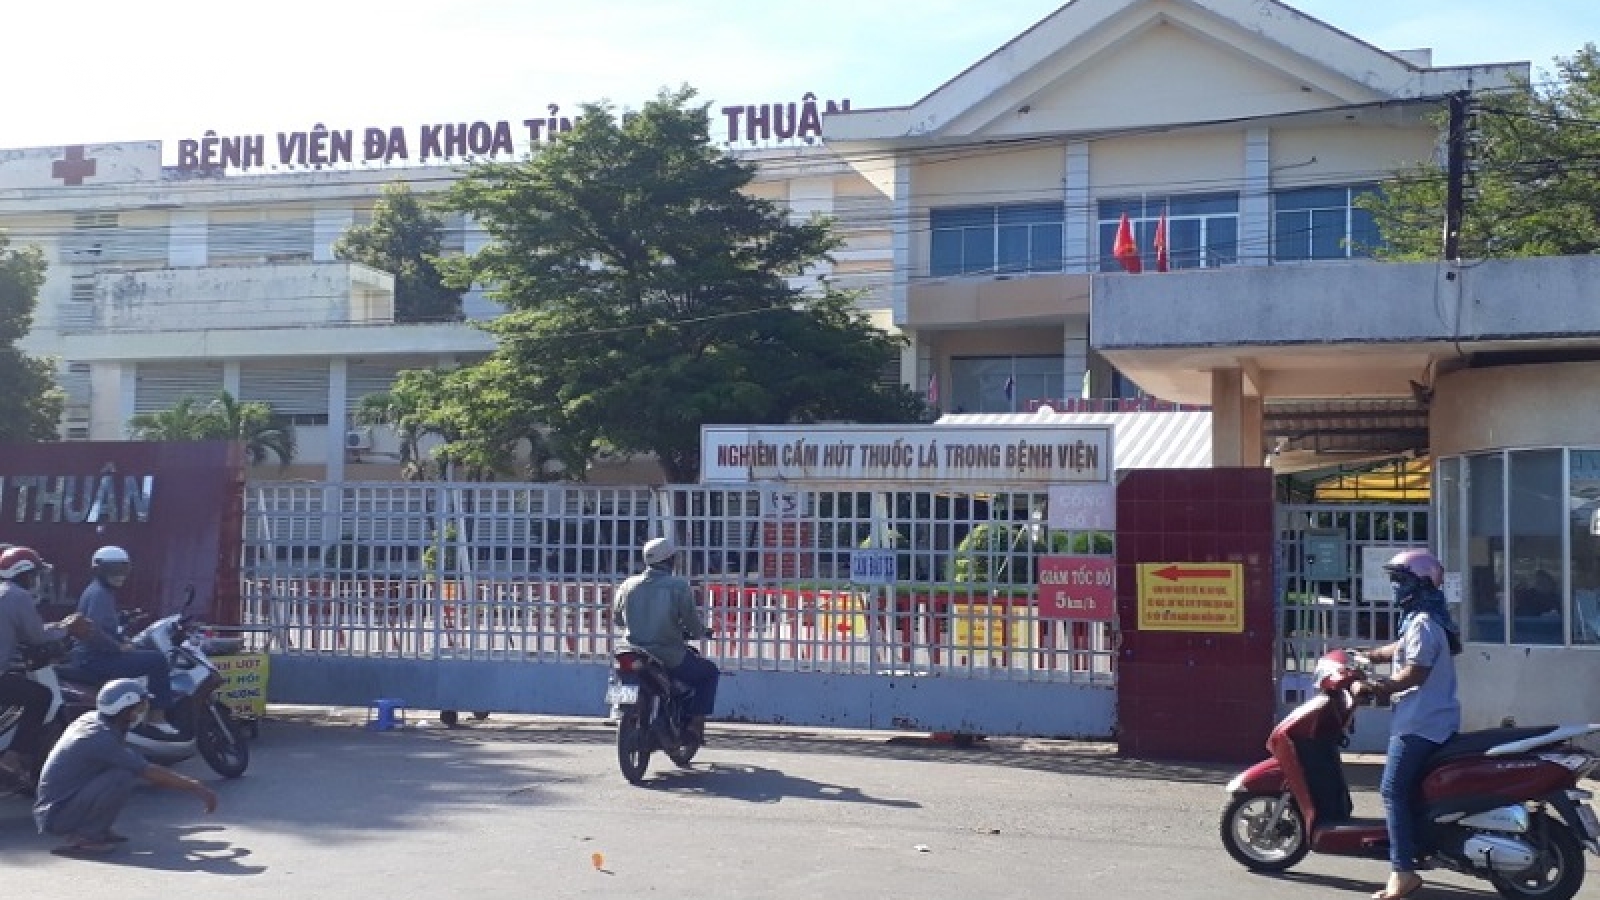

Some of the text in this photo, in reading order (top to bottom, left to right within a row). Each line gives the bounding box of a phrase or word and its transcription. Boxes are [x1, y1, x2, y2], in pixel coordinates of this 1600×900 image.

[277, 123, 353, 170] VIỆN
[364, 126, 409, 162] ĐA
[420, 120, 515, 159] KHOA
[717, 437, 1099, 472] NGHIÊM CẤM HÚT THUỐC LÁ TRONG BỆNH VIỆN
[1040, 563, 1069, 585] GIẢM
[1072, 563, 1093, 585] TỐC
